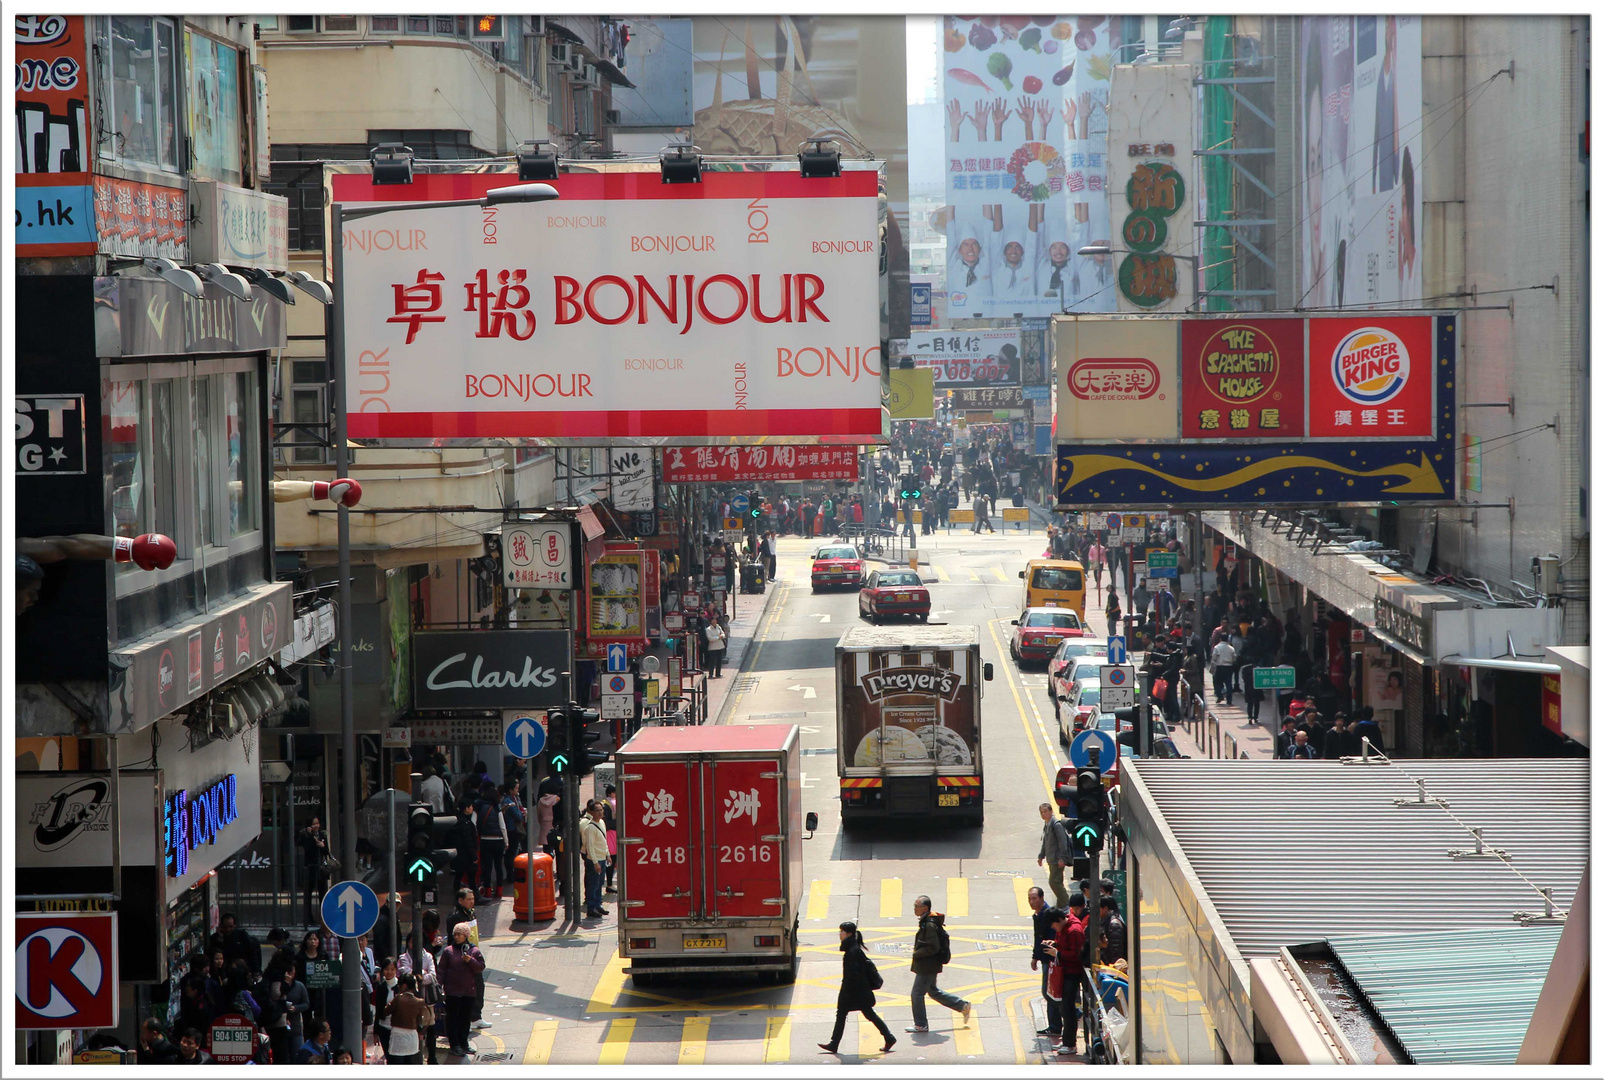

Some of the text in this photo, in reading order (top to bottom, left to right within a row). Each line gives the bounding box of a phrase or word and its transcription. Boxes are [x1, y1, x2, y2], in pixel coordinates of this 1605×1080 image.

[950, 158, 1006, 172] 為您健康
[1071, 153, 1101, 168] 我是
[1048, 171, 1107, 192] 有營食
[547, 216, 607, 228] BONJOUR
[342, 229, 429, 255] NJOUR
[631, 235, 716, 255] BONJOUR
[812, 240, 874, 255] BONJOUR
[553, 272, 831, 336] BONJOUR
[183, 291, 240, 349] EVERLAST
[1221, 329, 1256, 350] THE
[625, 359, 684, 371] BONJOUR
[1343, 342, 1397, 370] BURGER
[1345, 354, 1400, 388] KING
[465, 373, 594, 403] BONJOUR
[1220, 377, 1264, 398] HOUSE
[1200, 409, 1280, 429] 意粉屋
[1334, 409, 1405, 426] 漢堡王
[513, 535, 559, 562] 誠昌
[426, 653, 557, 690] Clarks
[192, 774, 239, 850] BONJOUR
[642, 787, 762, 827] 澳洲
[637, 846, 771, 864] 2418 2616
[700, 939, 723, 947] 7217
[27, 935, 97, 1012] K
[315, 963, 329, 971] 904
[215, 1031, 248, 1041] 904 905
